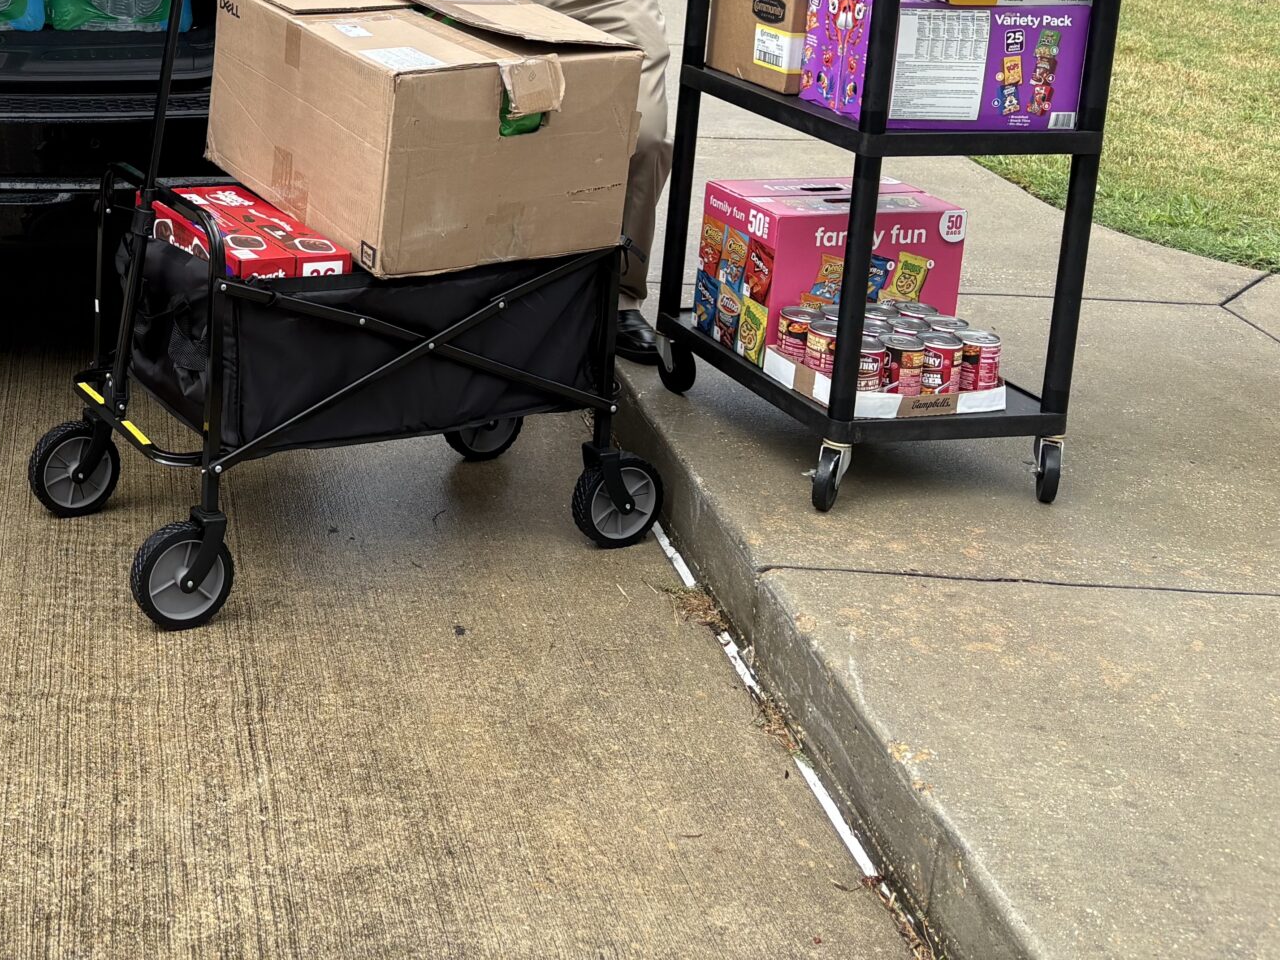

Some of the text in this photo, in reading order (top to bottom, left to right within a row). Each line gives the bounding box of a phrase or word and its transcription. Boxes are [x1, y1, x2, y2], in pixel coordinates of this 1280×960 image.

[753, 0, 785, 19] Community
[995, 13, 1073, 28] Variety Pack
[1006, 31, 1024, 44] 25
[1007, 63, 1020, 73] POPS
[709, 195, 746, 222] family fun
[747, 208, 765, 238] 50
[762, 216, 770, 240] BAGS
[946, 214, 963, 231] 50
[704, 226, 723, 244] Cheetos
[891, 224, 927, 245] fun
[728, 239, 747, 258] Cheetos
[750, 251, 769, 276] Doritos
[698, 281, 714, 305] Doritos
[911, 398, 951, 410] Campbell's
